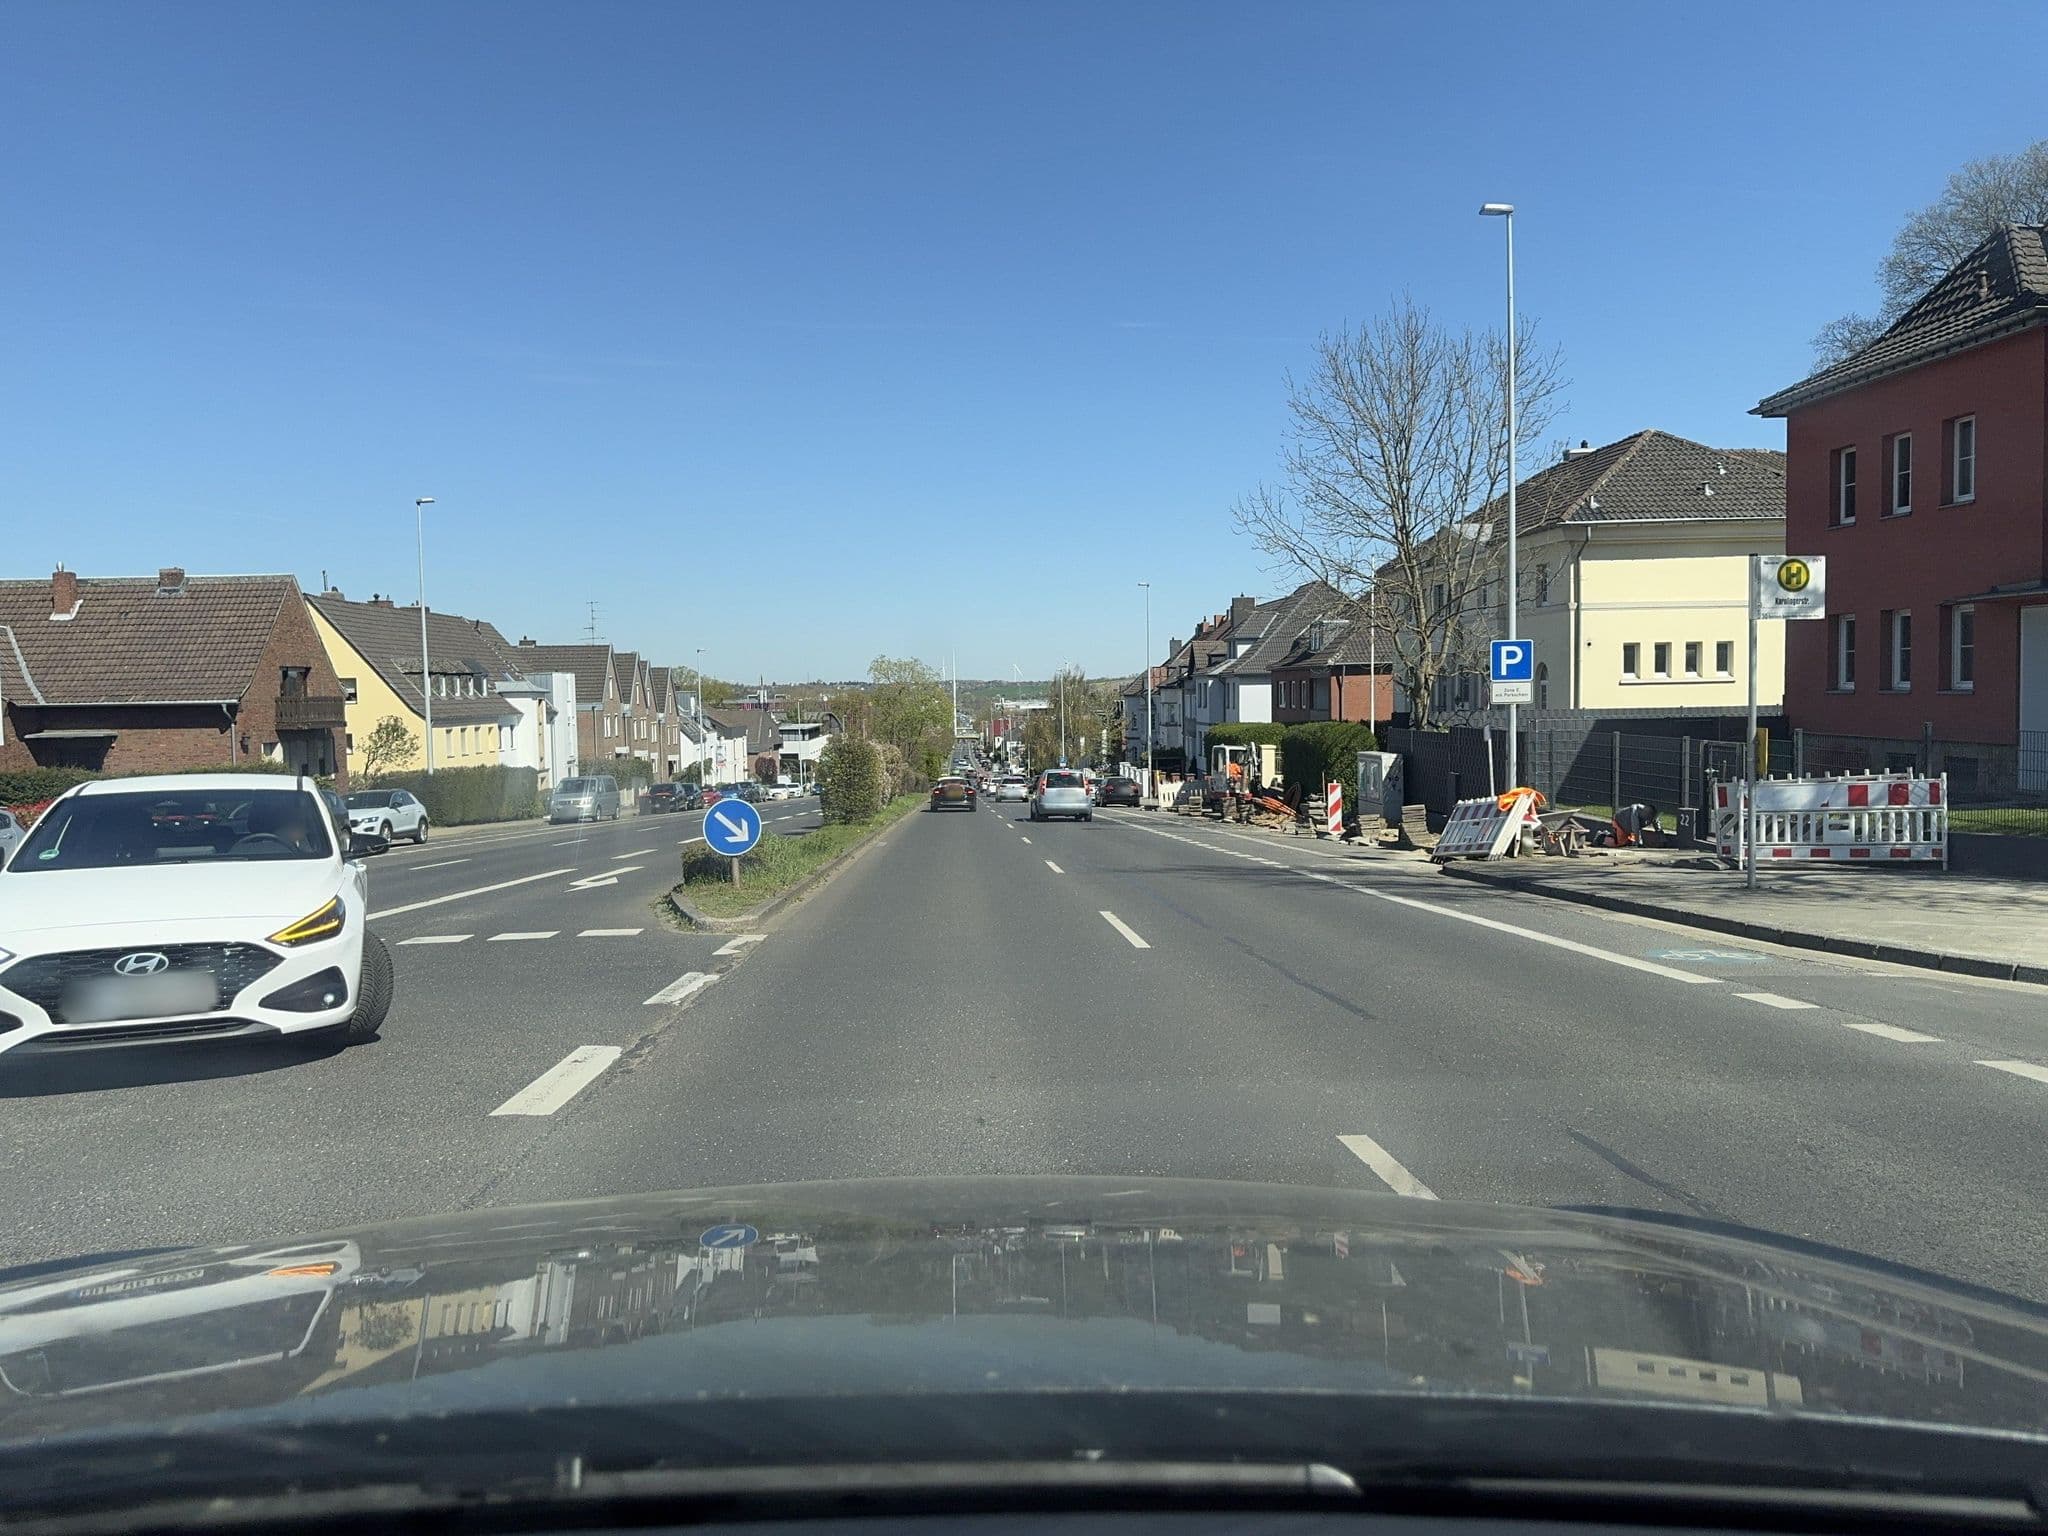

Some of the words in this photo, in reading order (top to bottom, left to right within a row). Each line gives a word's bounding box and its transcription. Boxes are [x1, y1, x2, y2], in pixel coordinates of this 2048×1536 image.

[1785, 566, 1802, 585] H
[1501, 645, 1523, 676] P
[1680, 813, 1690, 827] 22
